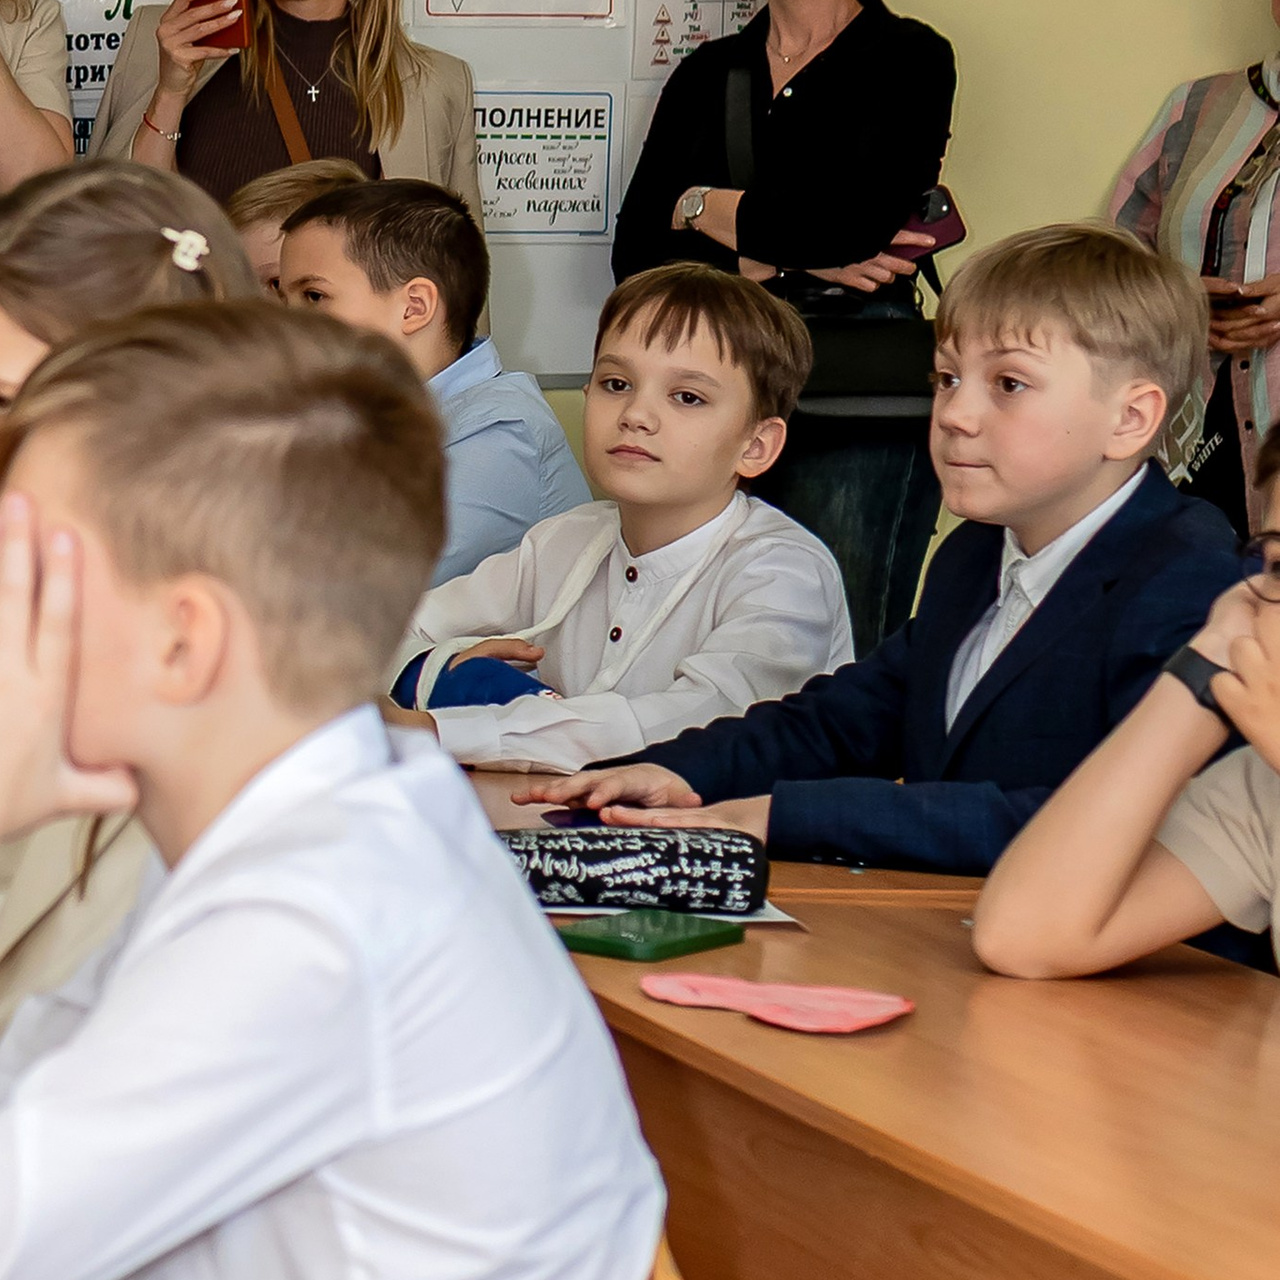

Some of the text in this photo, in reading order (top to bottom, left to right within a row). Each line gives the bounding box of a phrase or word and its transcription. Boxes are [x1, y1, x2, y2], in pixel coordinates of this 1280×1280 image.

[473, 108, 606, 129] ПОЛНЕНИЕ
[497, 170, 587, 190] косвенных
[526, 194, 601, 226] падежей
[1191, 432, 1223, 472] WHITE
